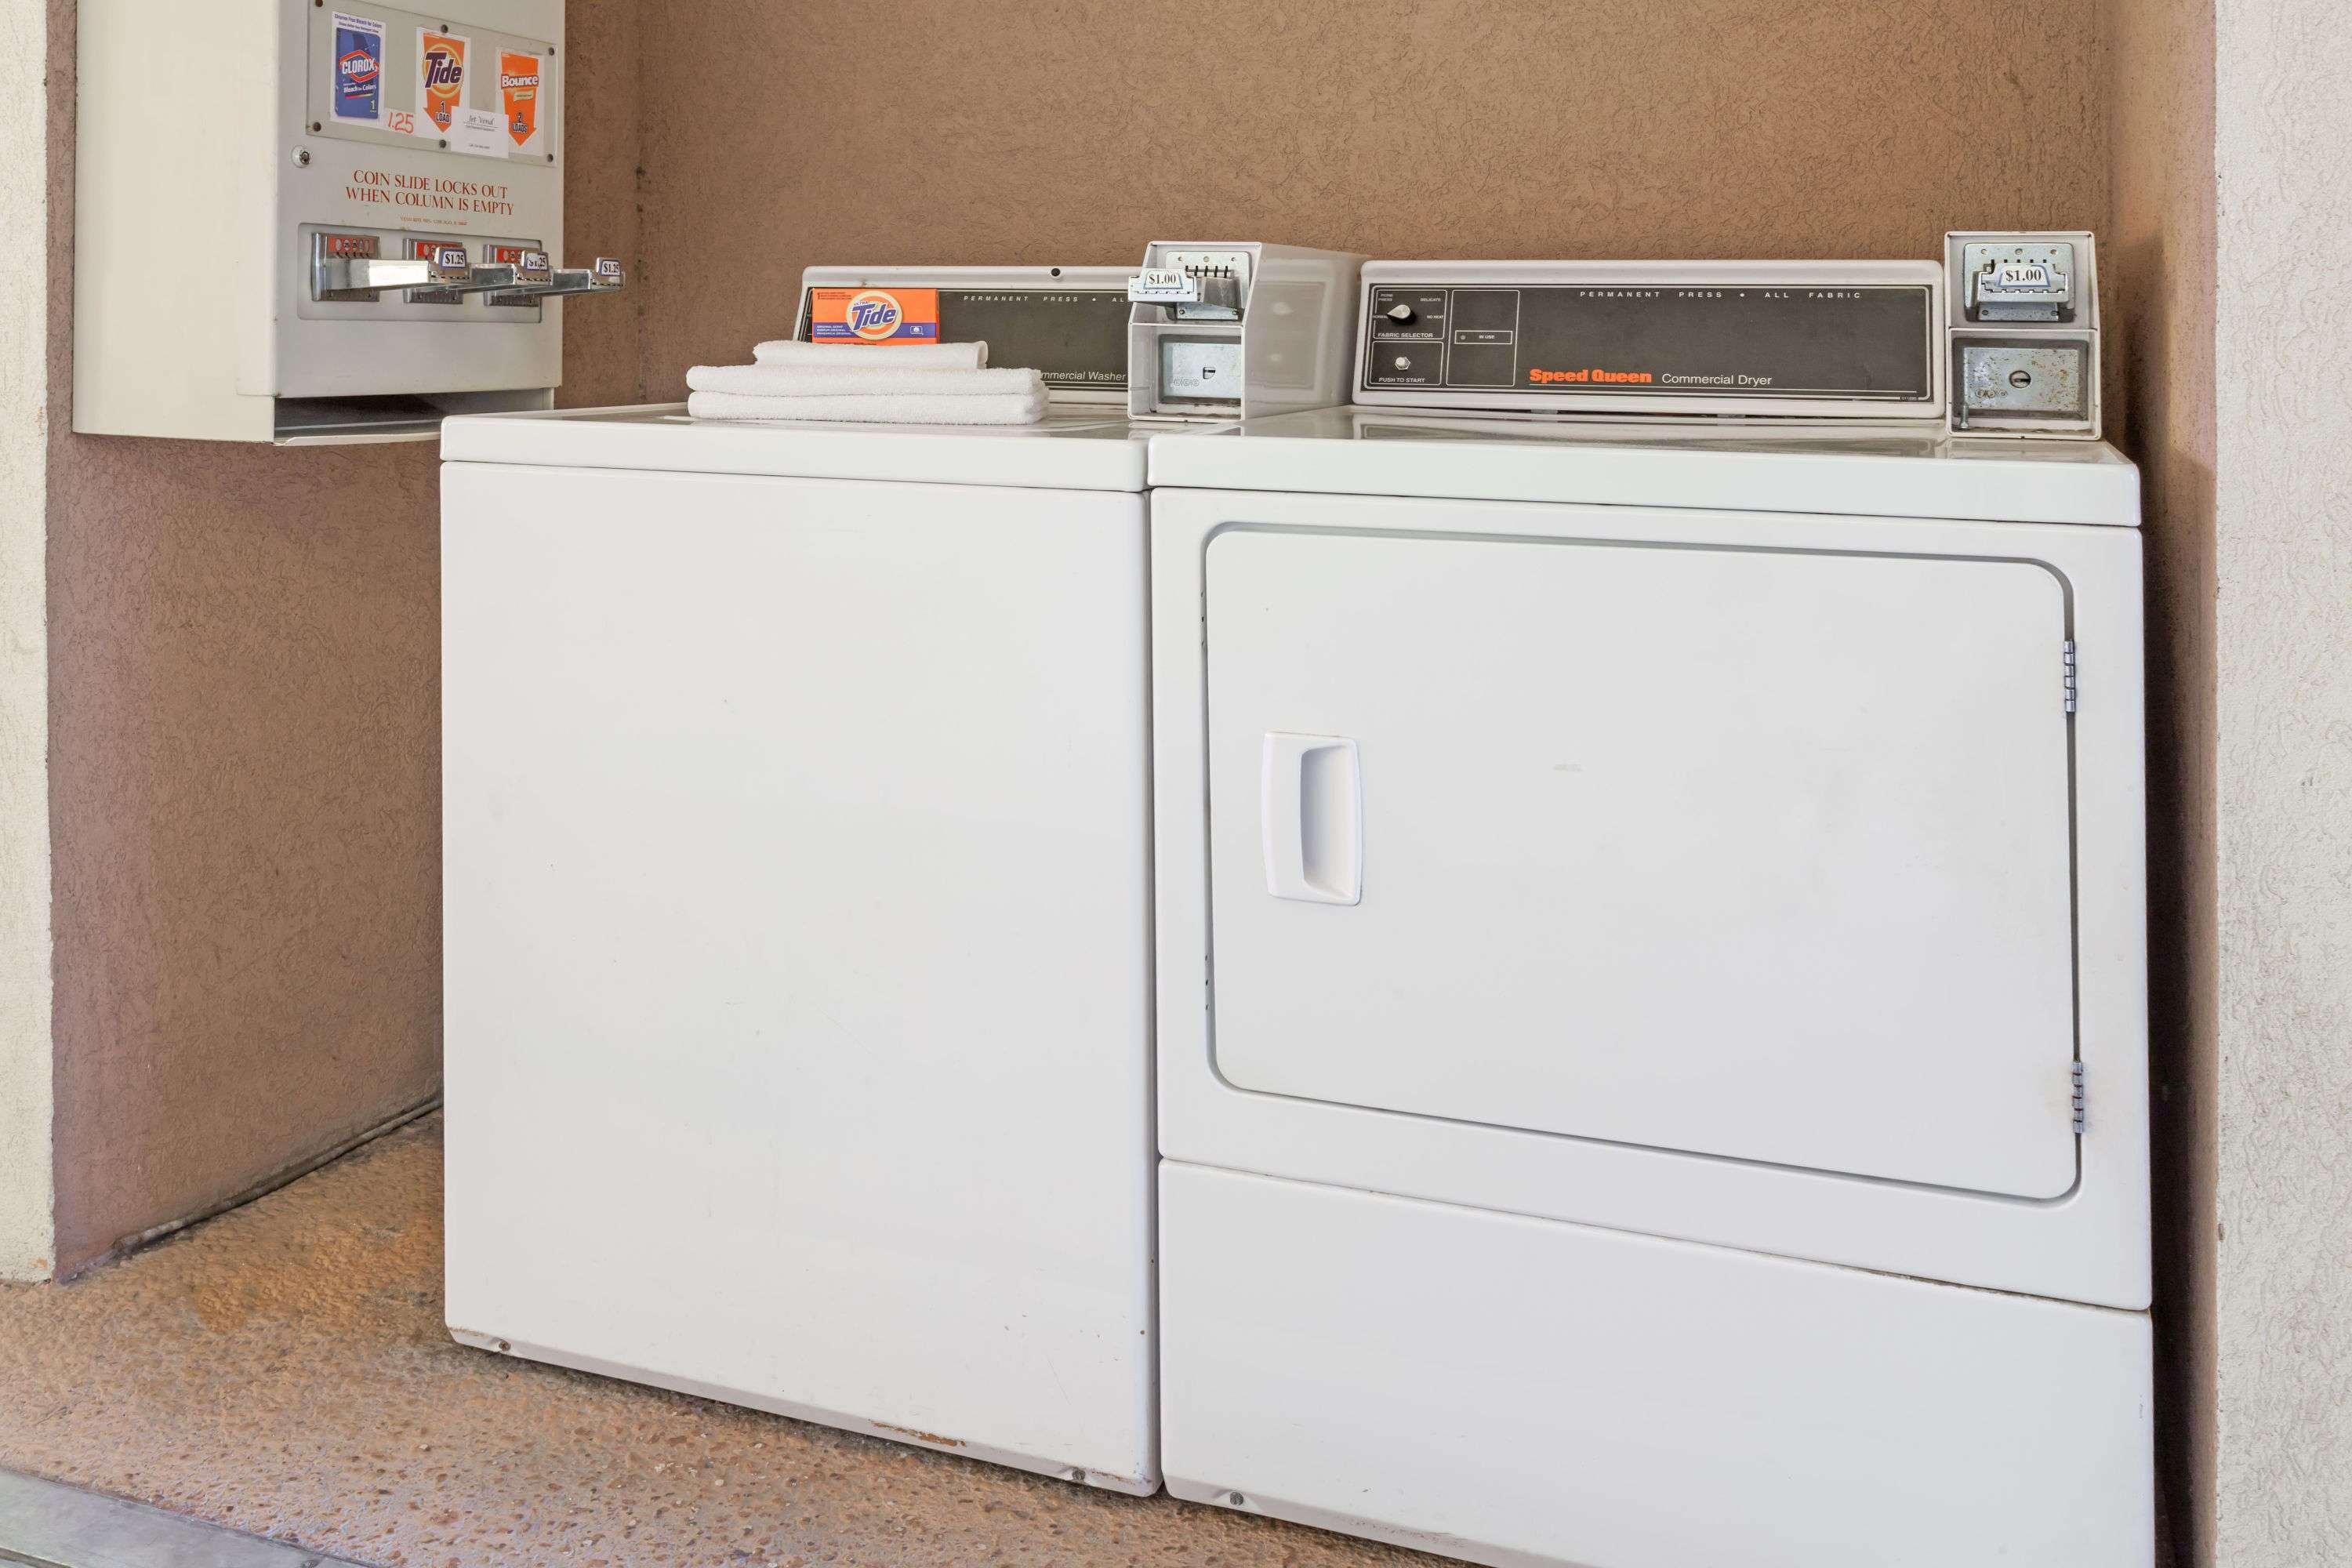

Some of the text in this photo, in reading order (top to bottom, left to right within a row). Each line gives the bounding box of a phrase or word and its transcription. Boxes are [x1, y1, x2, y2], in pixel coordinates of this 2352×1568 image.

[425, 52, 463, 88] Tide
[502, 75, 539, 87] Bounce
[370, 100, 375, 110] 1
[441, 101, 445, 113] 1
[388, 112, 414, 133] 1.25
[436, 112, 450, 122] LOAD
[354, 169, 508, 199] COIN SLIDE LOCKS OUT
[346, 187, 514, 216] WHEN COLUMN IS EMPTY
[445, 253, 464, 265] $1.25
[603, 263, 619, 273] $1.25
[1149, 273, 1176, 285] $1.00
[2005, 269, 2042, 281] $1.00
[852, 303, 897, 331] Tide
[1041, 370, 1126, 381] mmercial Washer
[1530, 368, 1772, 387] Speed Queen Commercial Dryer
